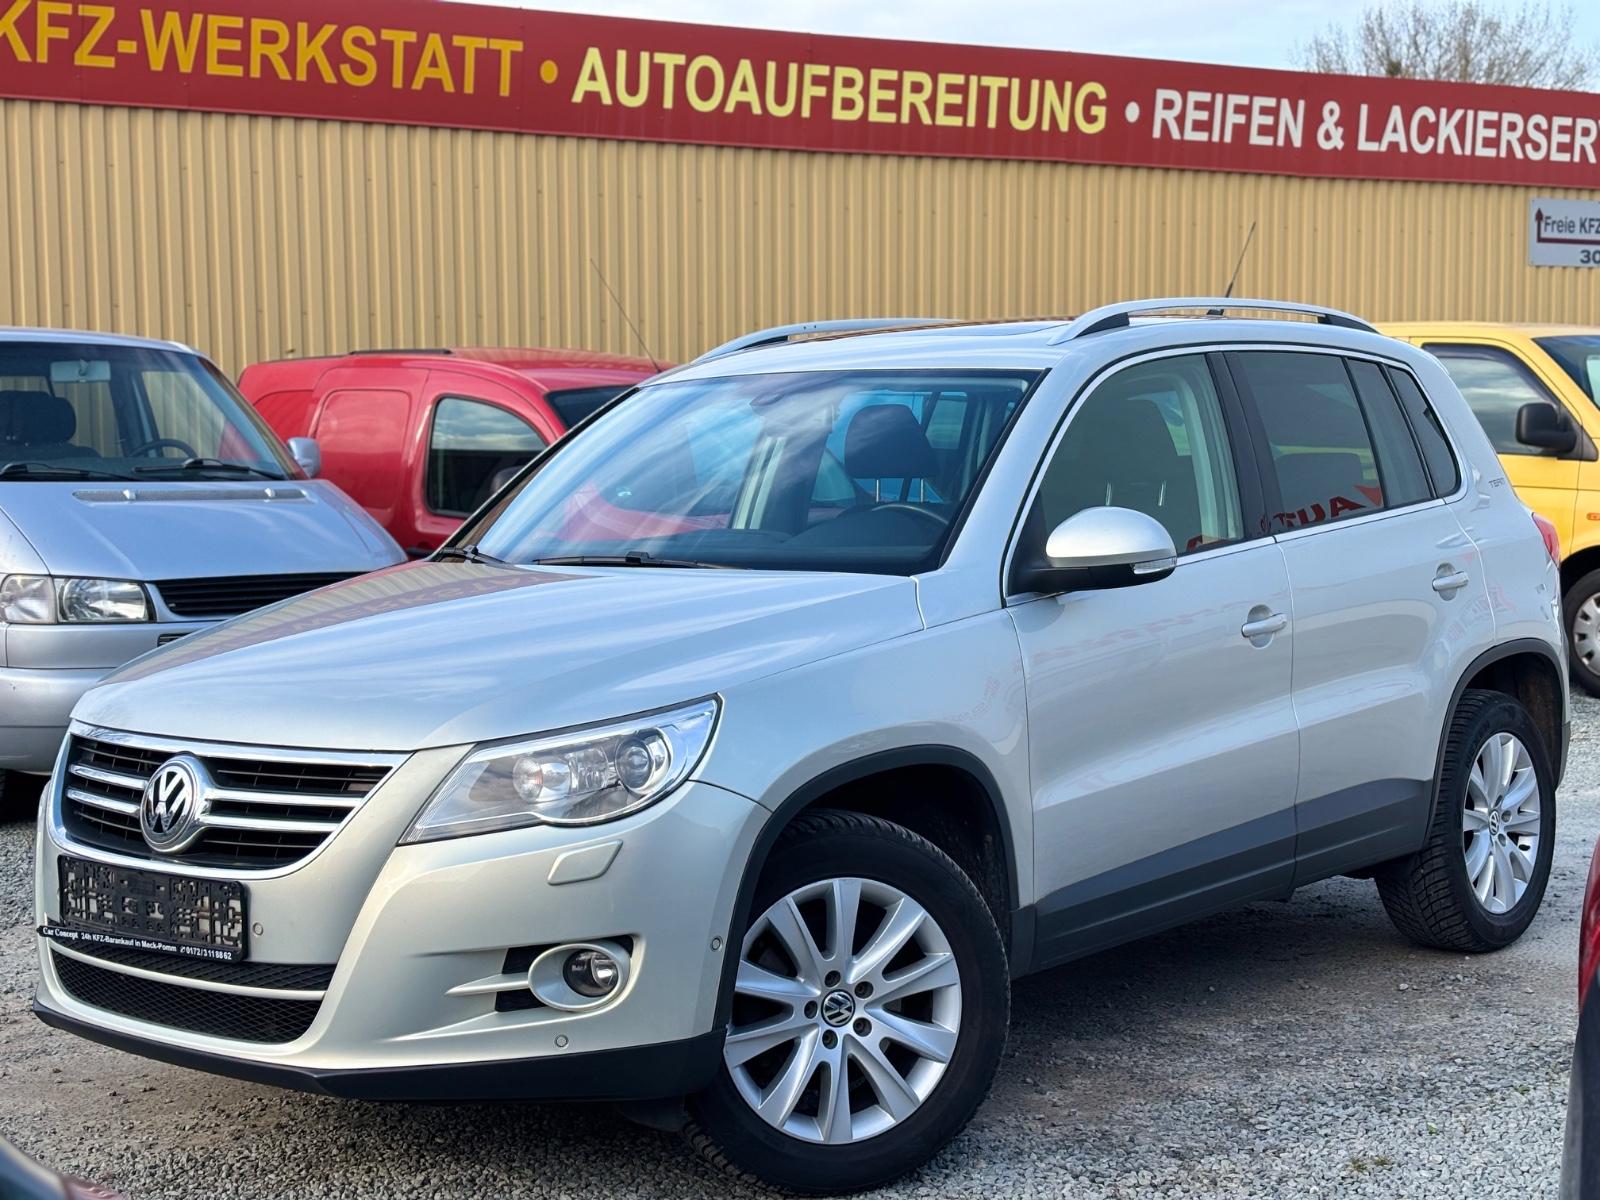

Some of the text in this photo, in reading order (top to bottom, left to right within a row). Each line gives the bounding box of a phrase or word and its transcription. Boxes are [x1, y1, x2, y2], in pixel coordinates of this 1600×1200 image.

[0, 0, 1600, 164] KFZ-WERKSTATT AUTOAUFBEREITUNG REIFEN & LACKIERSER
[1544, 215, 1600, 235] Freie KFZ
[1580, 249, 1600, 264] 30
[42, 926, 54, 936] Car
[54, 928, 79, 941] Concept
[81, 932, 92, 941] 24h
[134, 938, 142, 947] in
